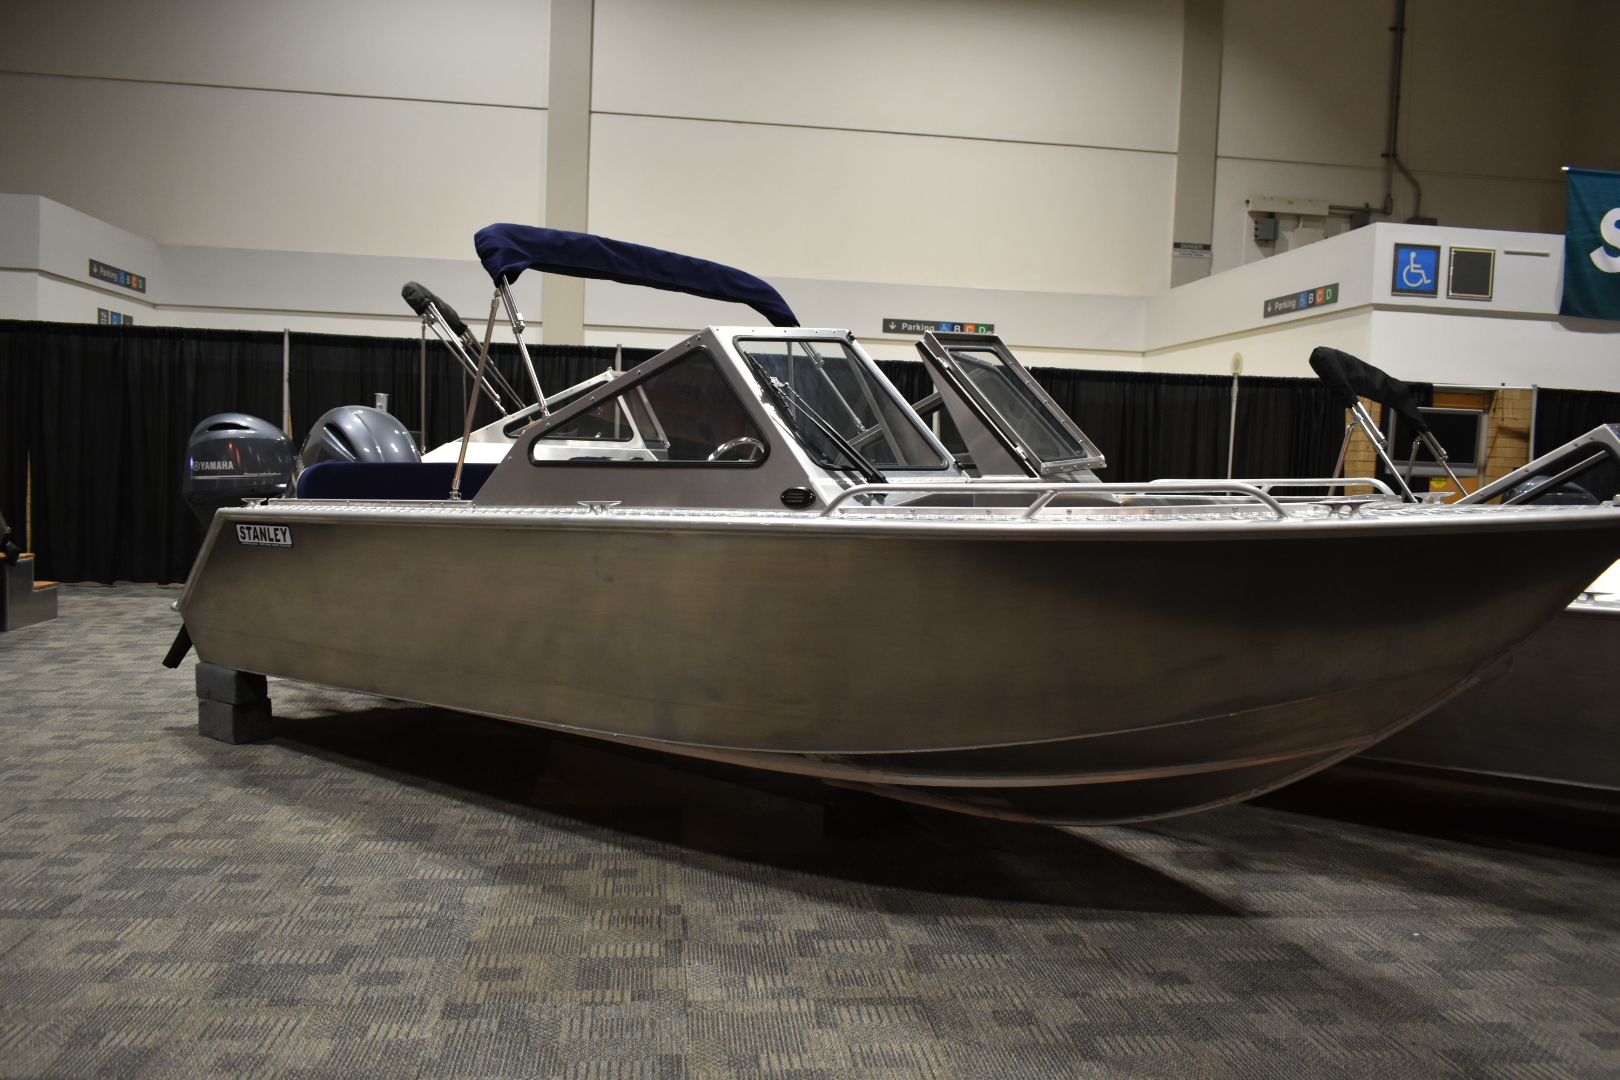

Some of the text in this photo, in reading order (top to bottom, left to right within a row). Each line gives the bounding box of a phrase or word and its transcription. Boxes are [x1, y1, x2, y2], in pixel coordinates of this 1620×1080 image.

[100, 266, 143, 288] Parking B C D
[1274, 288, 1332, 311] Parking B C D
[901, 322, 935, 332] Parking
[965, 325, 974, 333] C
[978, 326, 987, 334] D
[200, 460, 234, 470] YAMAHA
[239, 525, 288, 543] STANLEY
